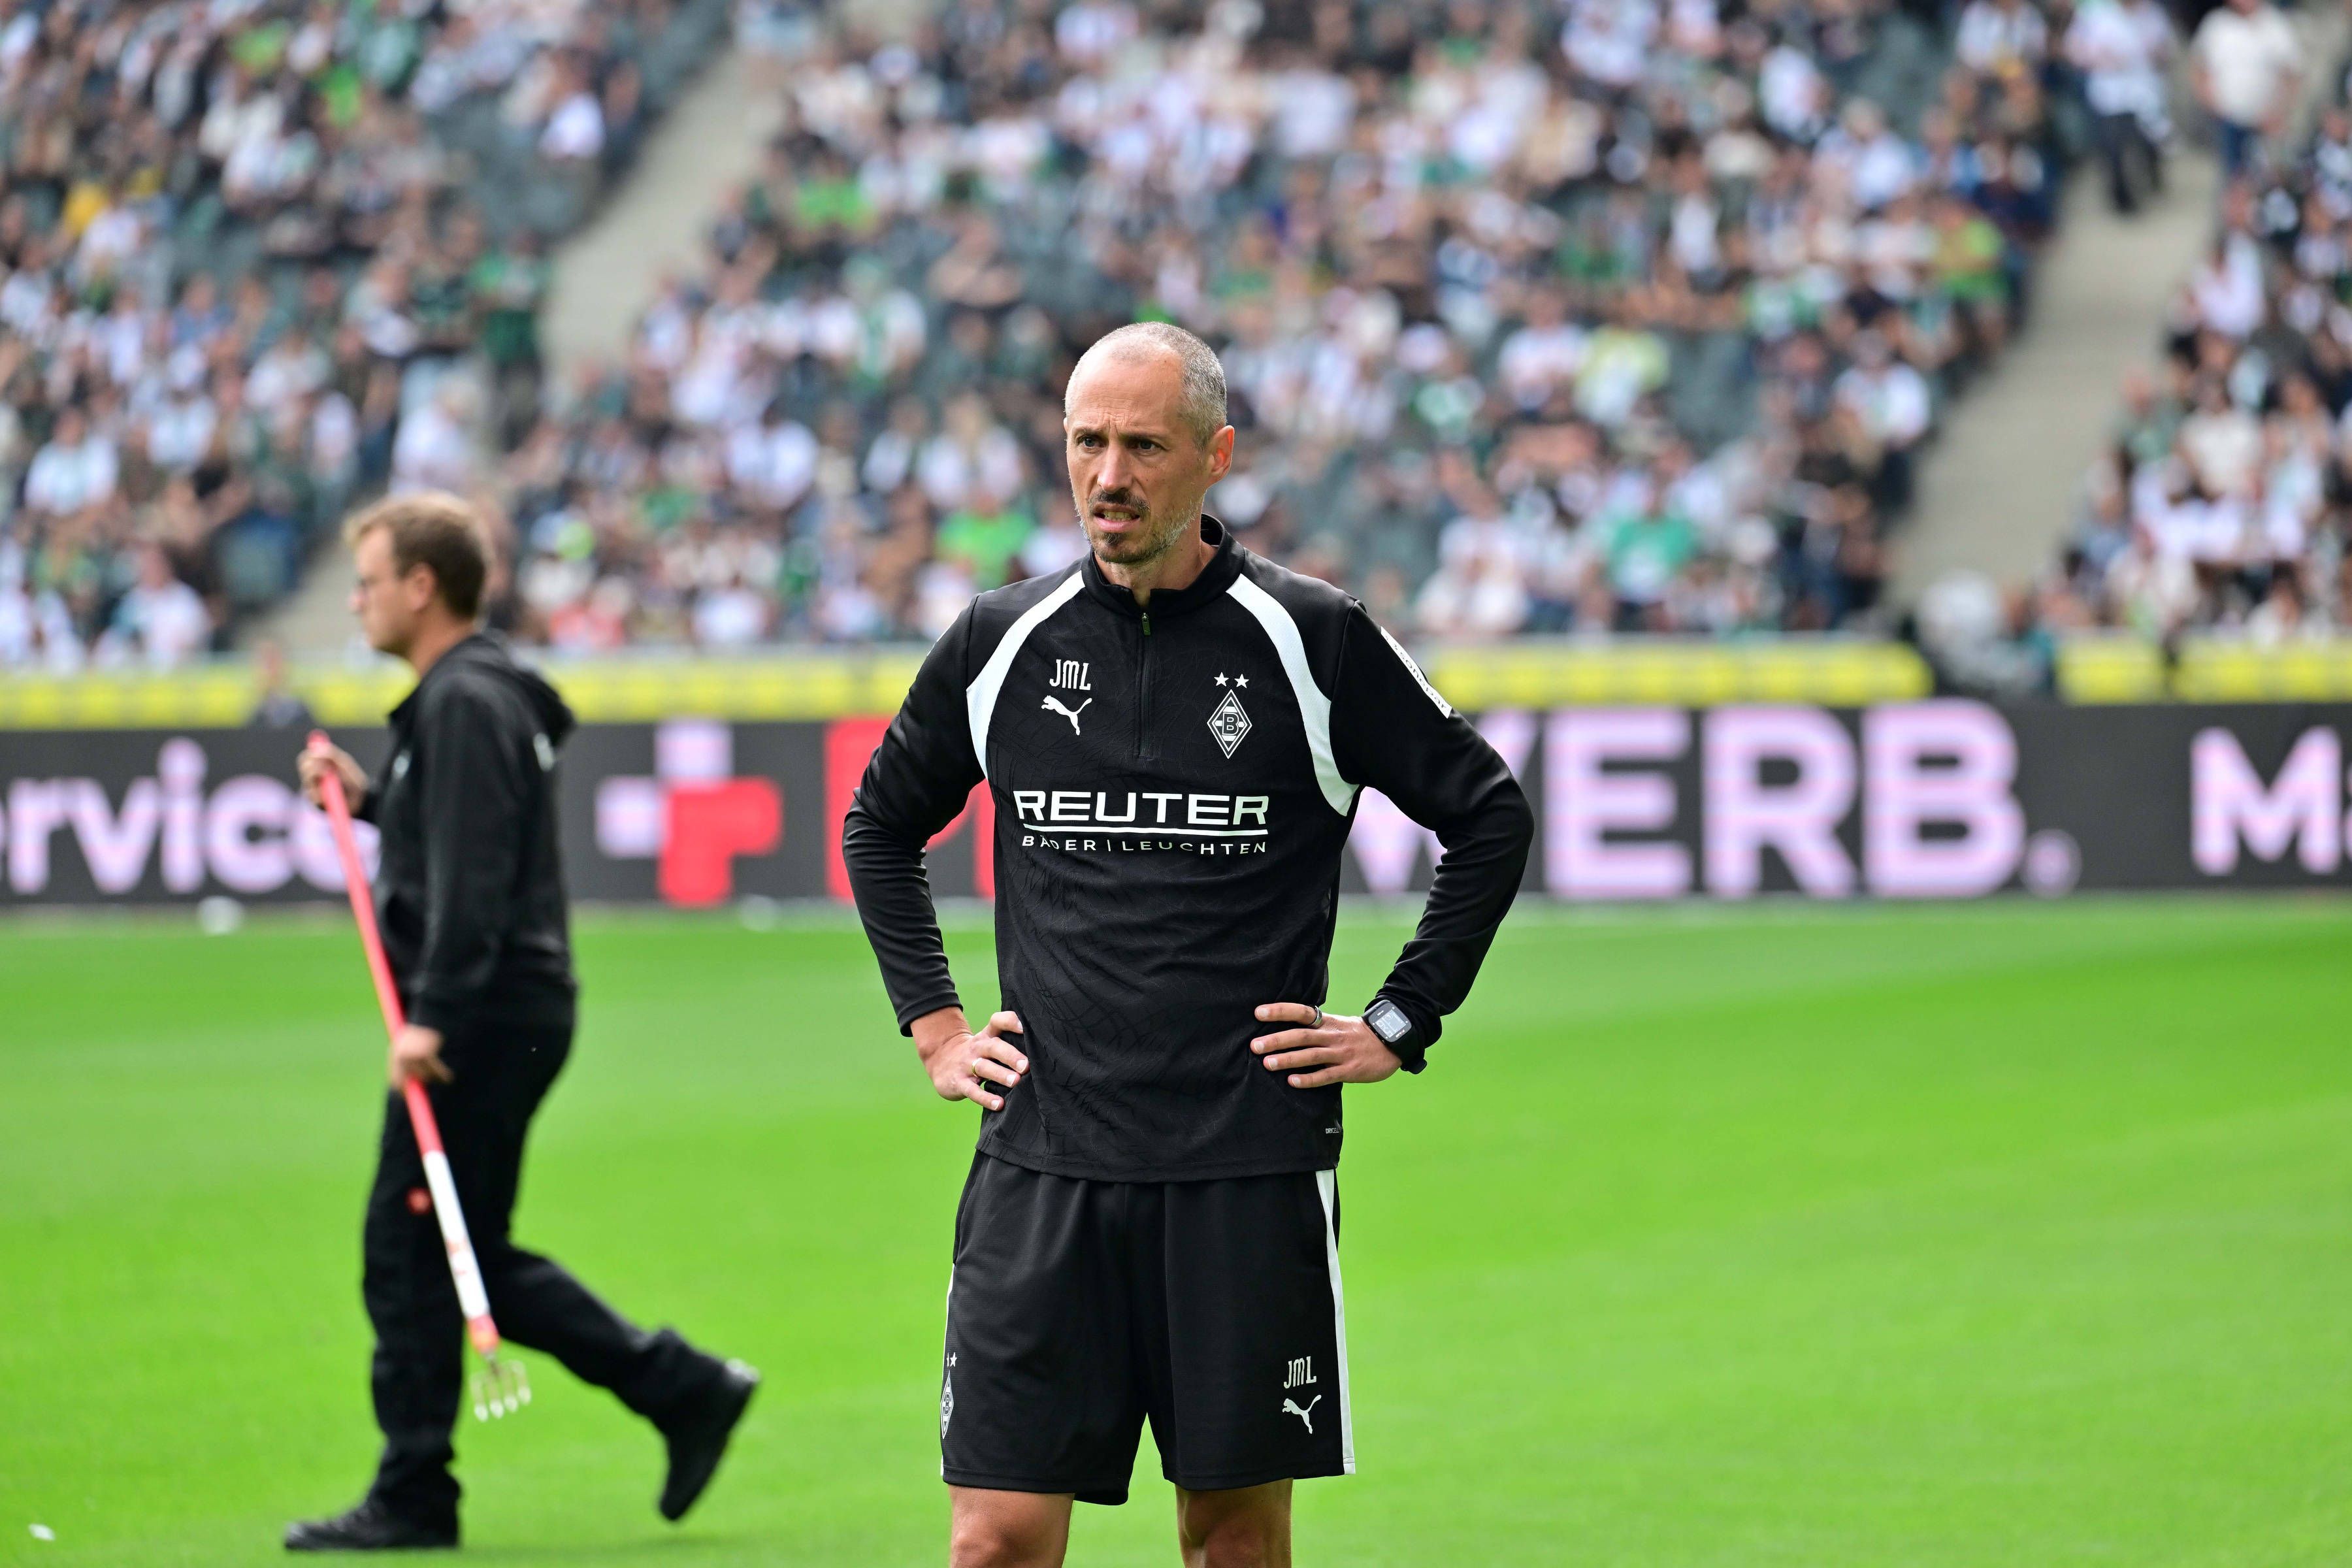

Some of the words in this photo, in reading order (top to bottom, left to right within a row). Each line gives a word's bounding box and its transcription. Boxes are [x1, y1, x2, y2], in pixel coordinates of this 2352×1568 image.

[1049, 659, 1091, 691] JML
[1013, 790, 1269, 826] REUTER
[1122, 841, 1266, 855] LEUCHTEN
[1283, 1356, 1317, 1389] JML
